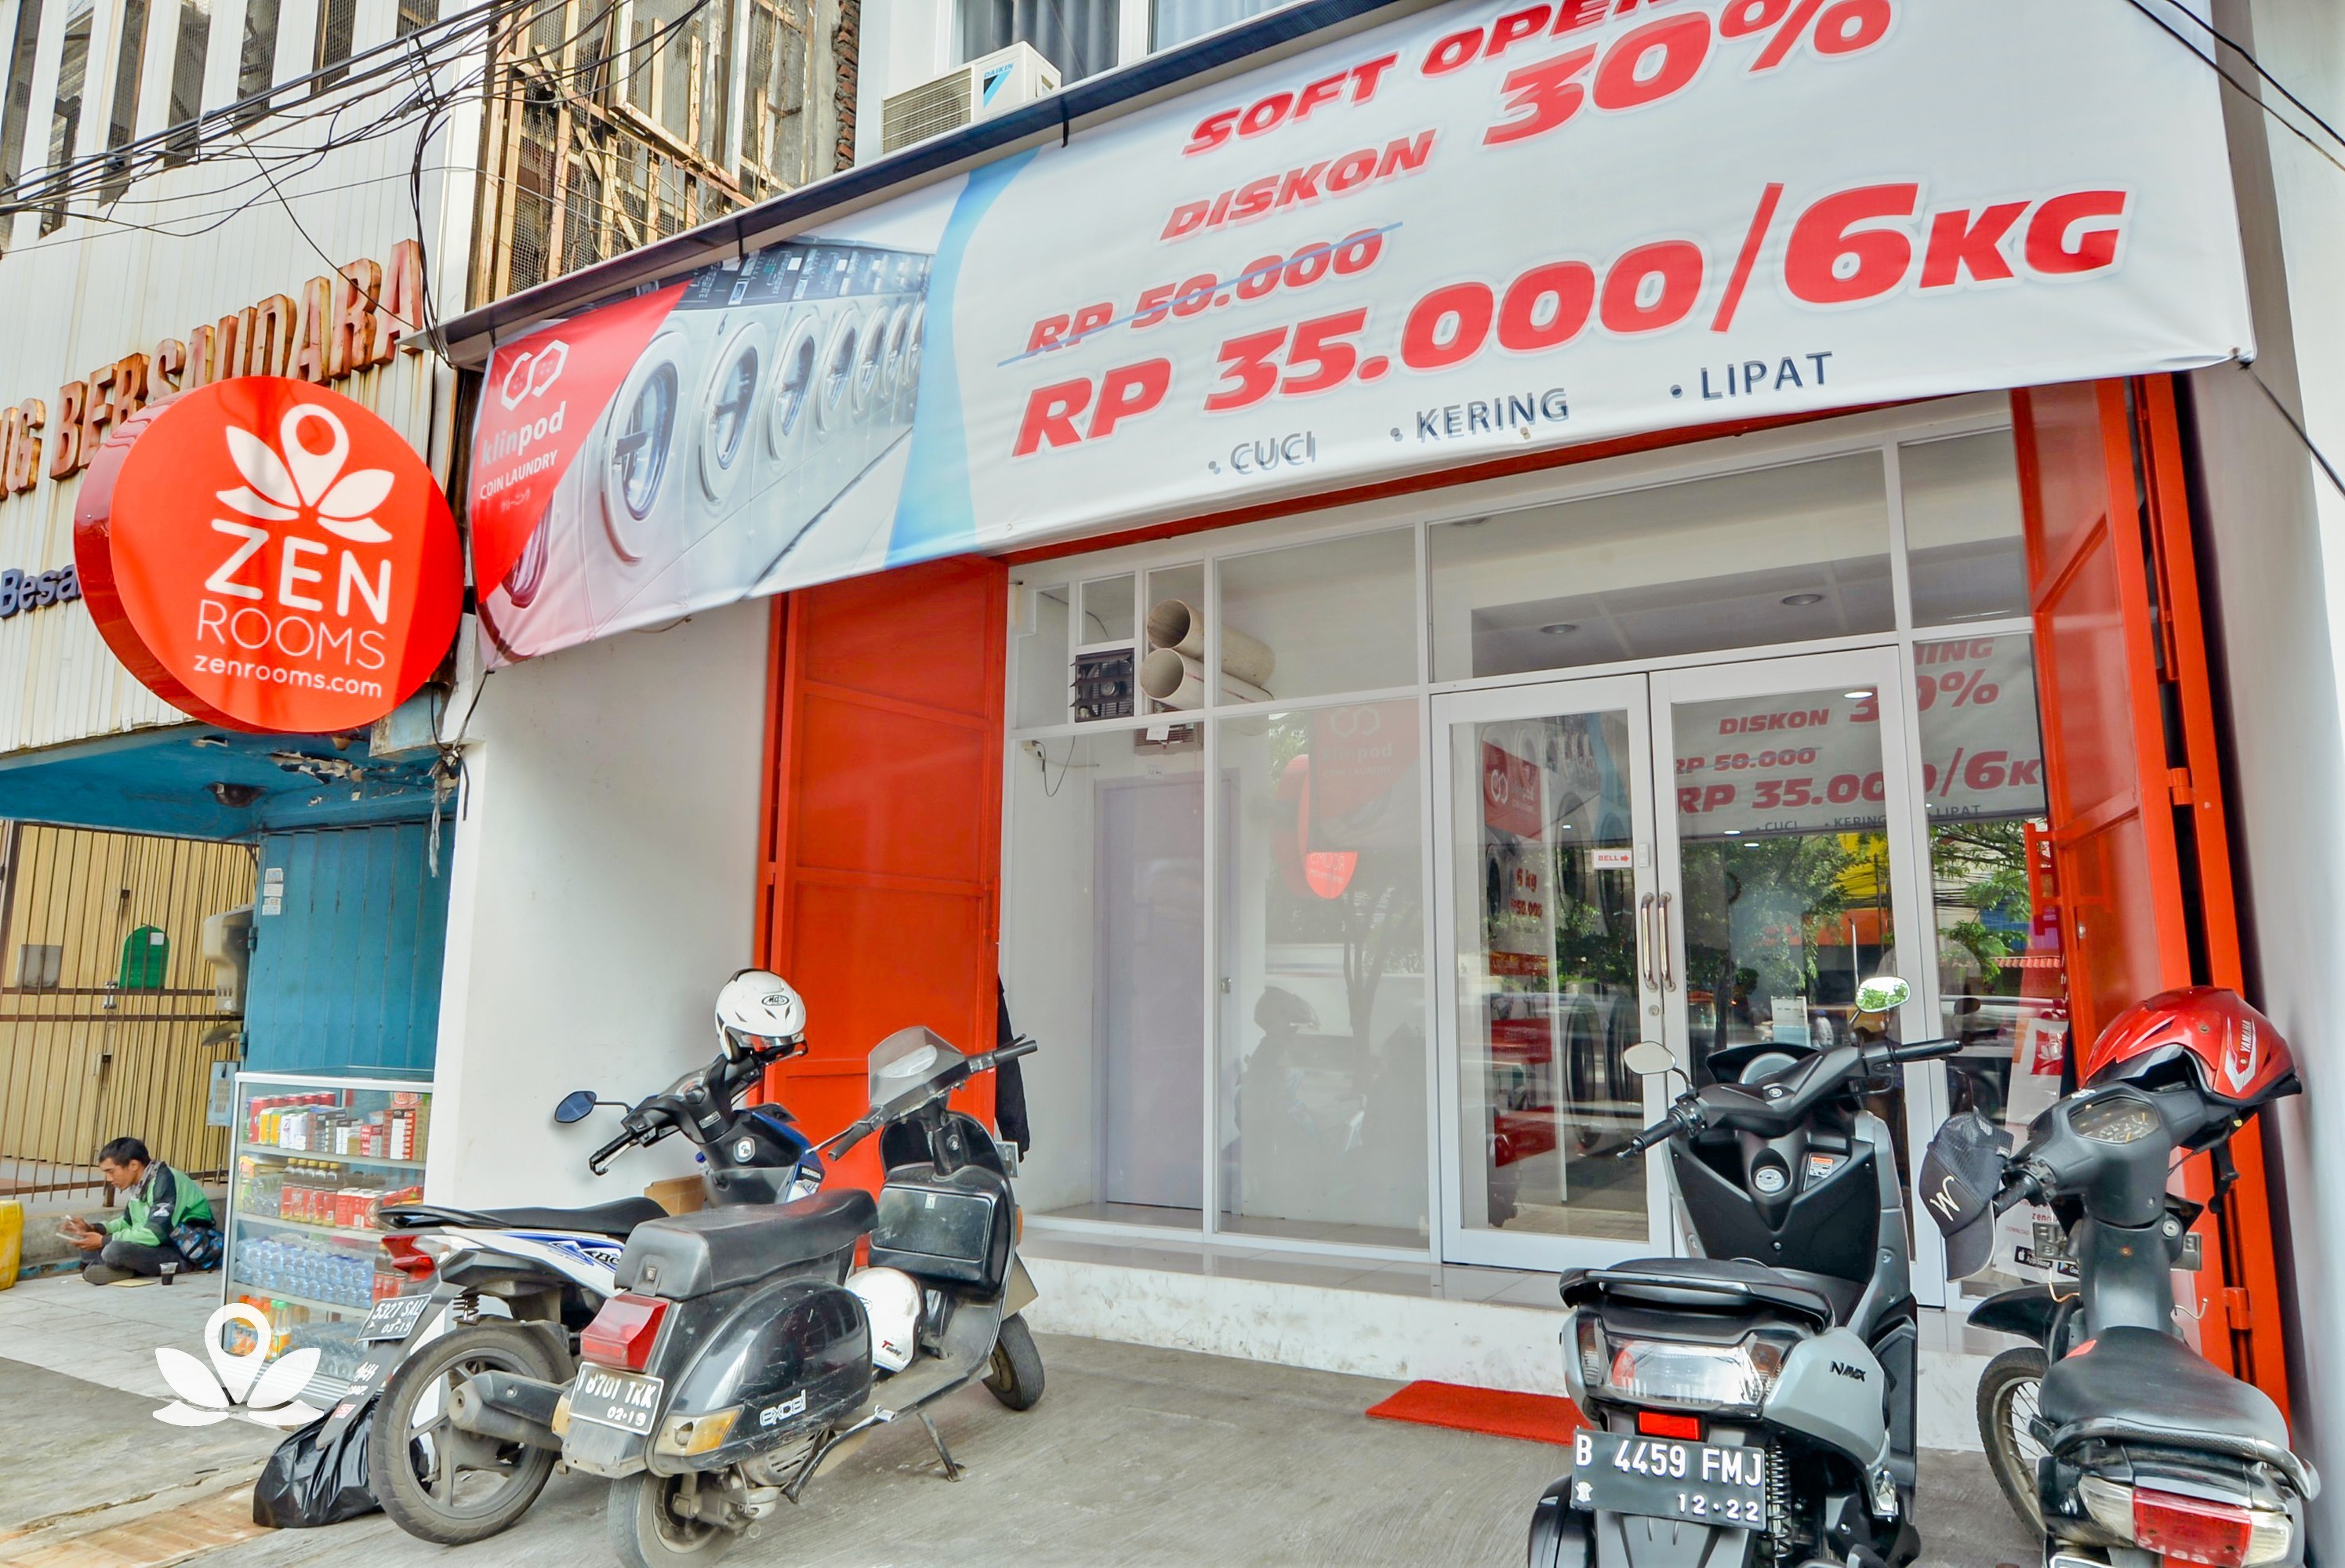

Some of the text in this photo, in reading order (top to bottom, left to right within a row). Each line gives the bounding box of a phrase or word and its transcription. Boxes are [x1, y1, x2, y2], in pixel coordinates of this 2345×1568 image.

[984, 63, 1014, 78] DAIKIN
[1160, 0, 1893, 242] DISKON 30%
[1182, 52, 1398, 158] SOFT
[1024, 227, 1385, 357] RP 50.000
[1700, 350, 1833, 401] LIPAT
[1011, 358, 1171, 459] RP
[1415, 387, 1568, 444] KERING
[481, 401, 567, 469] klinpod
[1230, 430, 1317, 475] CUCI
[480, 449, 559, 500] COIN LAUNDRY
[205, 519, 391, 624] ZEN
[197, 599, 386, 670] ROOMS
[194, 655, 382, 698] zenrooms.com
[1719, 709, 1829, 735] DISKON
[1714, 747, 1816, 771] 50.000
[1937, 805, 1981, 817] LIPAT
[2240, 1019, 2252, 1053] YAMAHA
[1575, 1434, 1762, 1486] B 4459 FMJ
